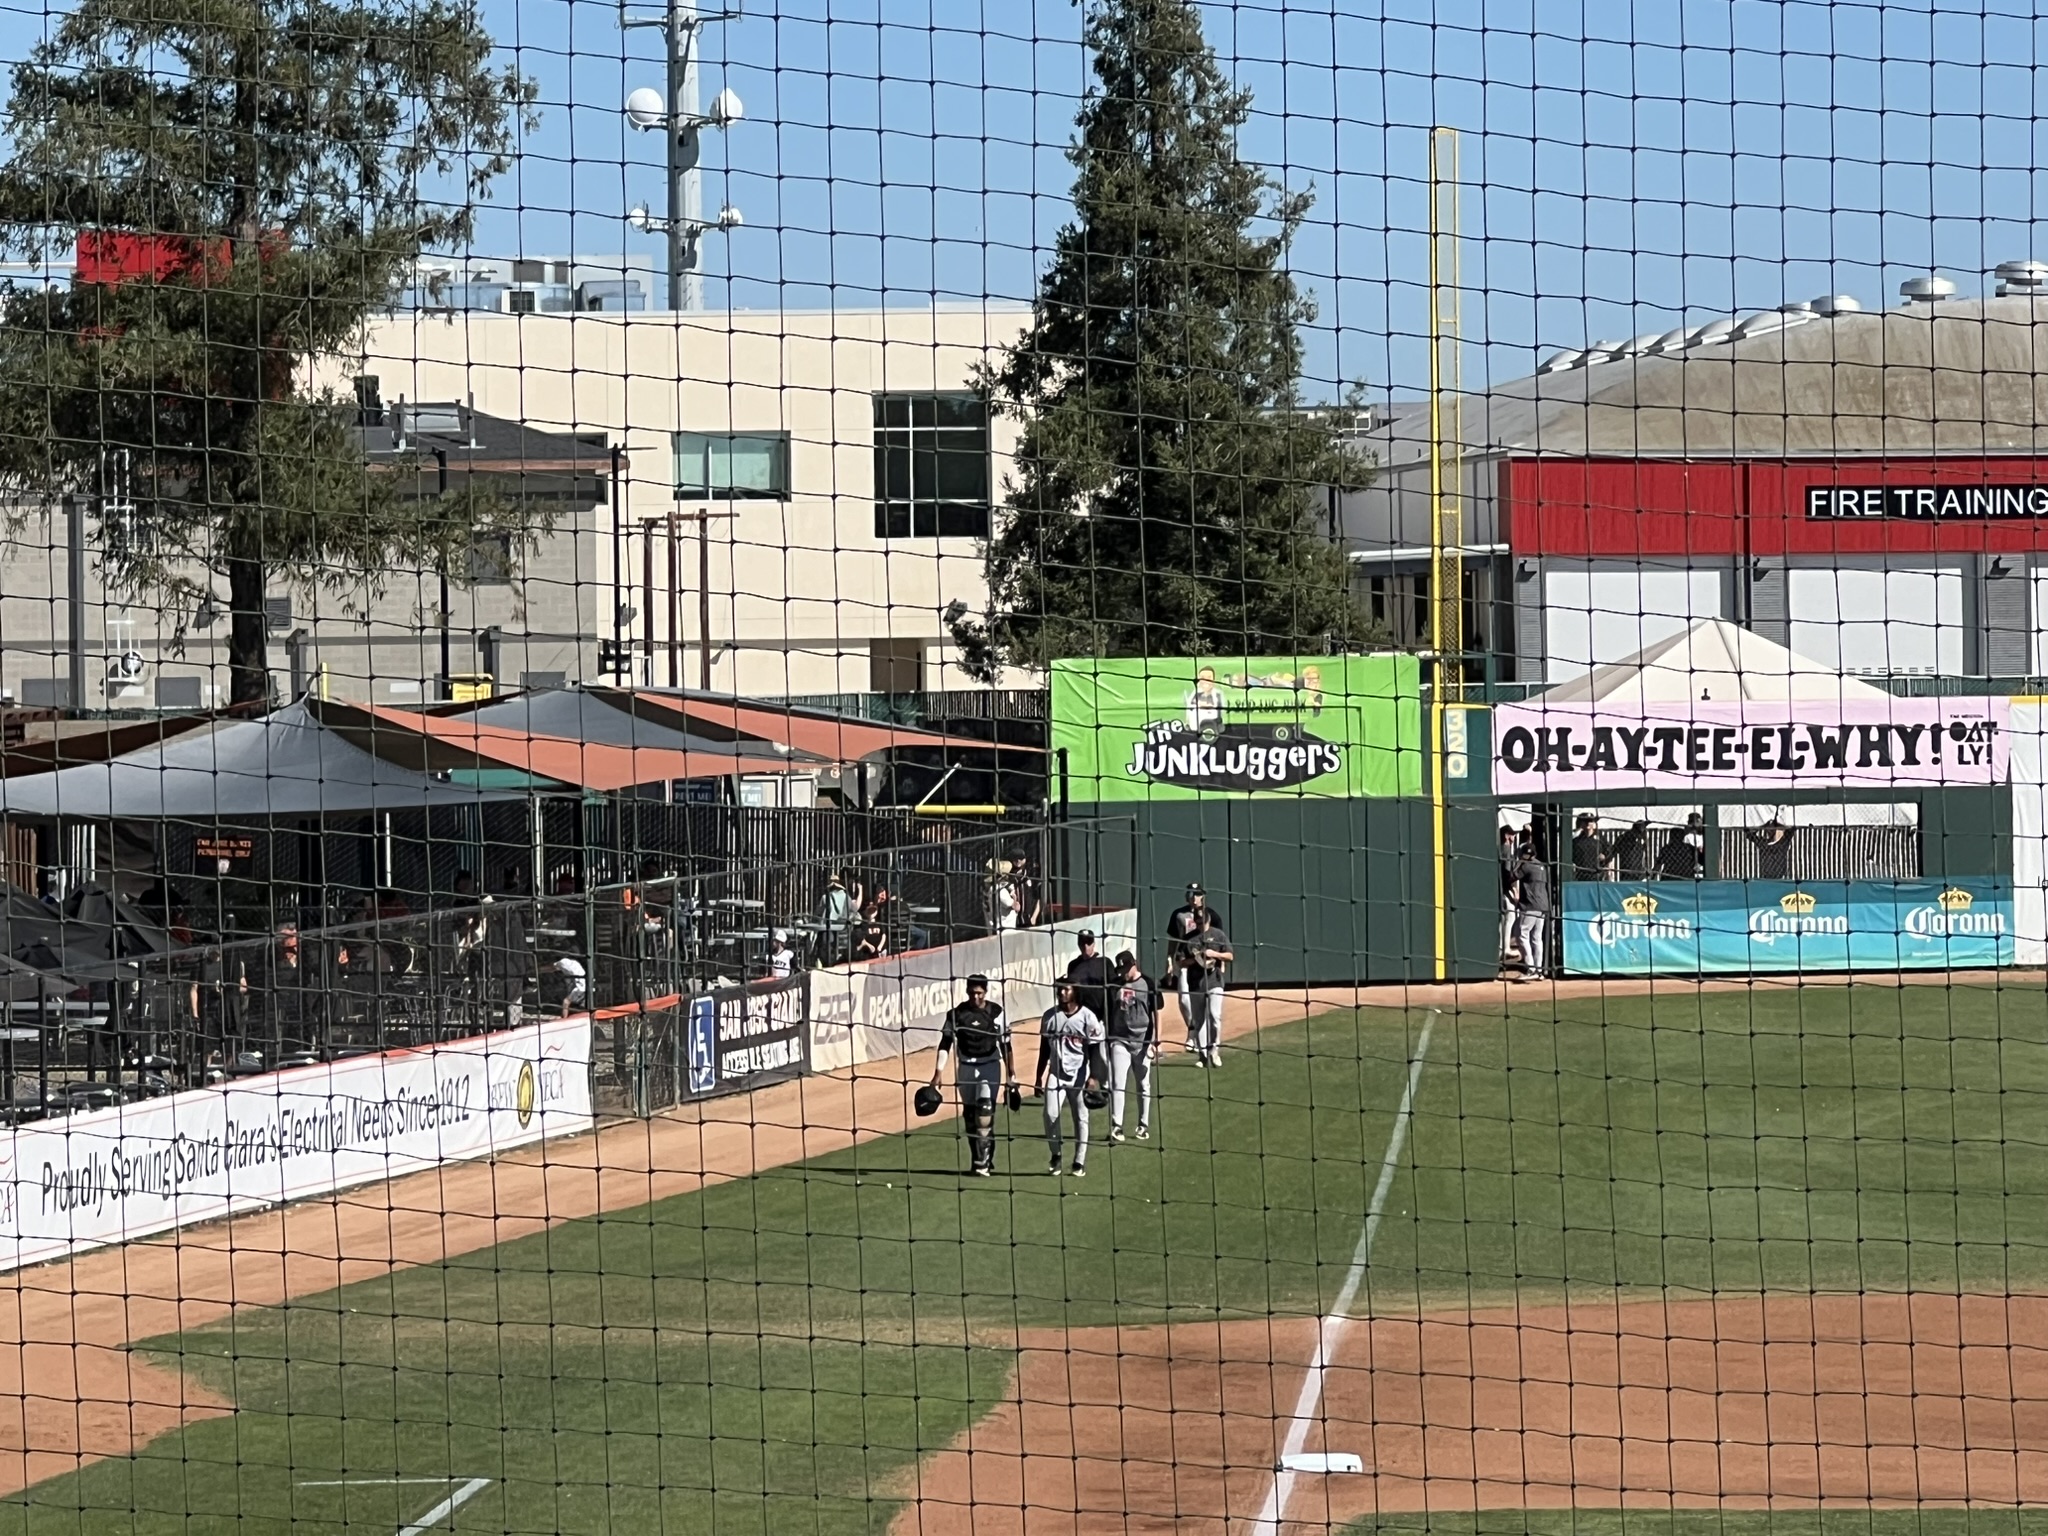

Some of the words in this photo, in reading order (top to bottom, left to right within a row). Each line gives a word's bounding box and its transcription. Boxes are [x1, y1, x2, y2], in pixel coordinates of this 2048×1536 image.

[1810, 489, 1883, 517] FIRE
[1893, 487, 2048, 516] TRAINING
[1141, 719, 1184, 745] The
[1501, 723, 1941, 774] OH-AY-TEE-EL-WHY!
[1957, 743, 1993, 766] LY!
[1588, 911, 1692, 948] Corona
[1749, 909, 1848, 946] Corona
[1904, 905, 2006, 942] Corona
[720, 999, 741, 1042] SAN
[42, 1151, 107, 1218] Proudly
[111, 1140, 173, 1201] Serving
[176, 1128, 220, 1184] Santa
[223, 1112, 277, 1171] Clara's
[351, 1094, 395, 1145] Needs
[397, 1086, 437, 1135] Since
[441, 1074, 470, 1126] 1912
